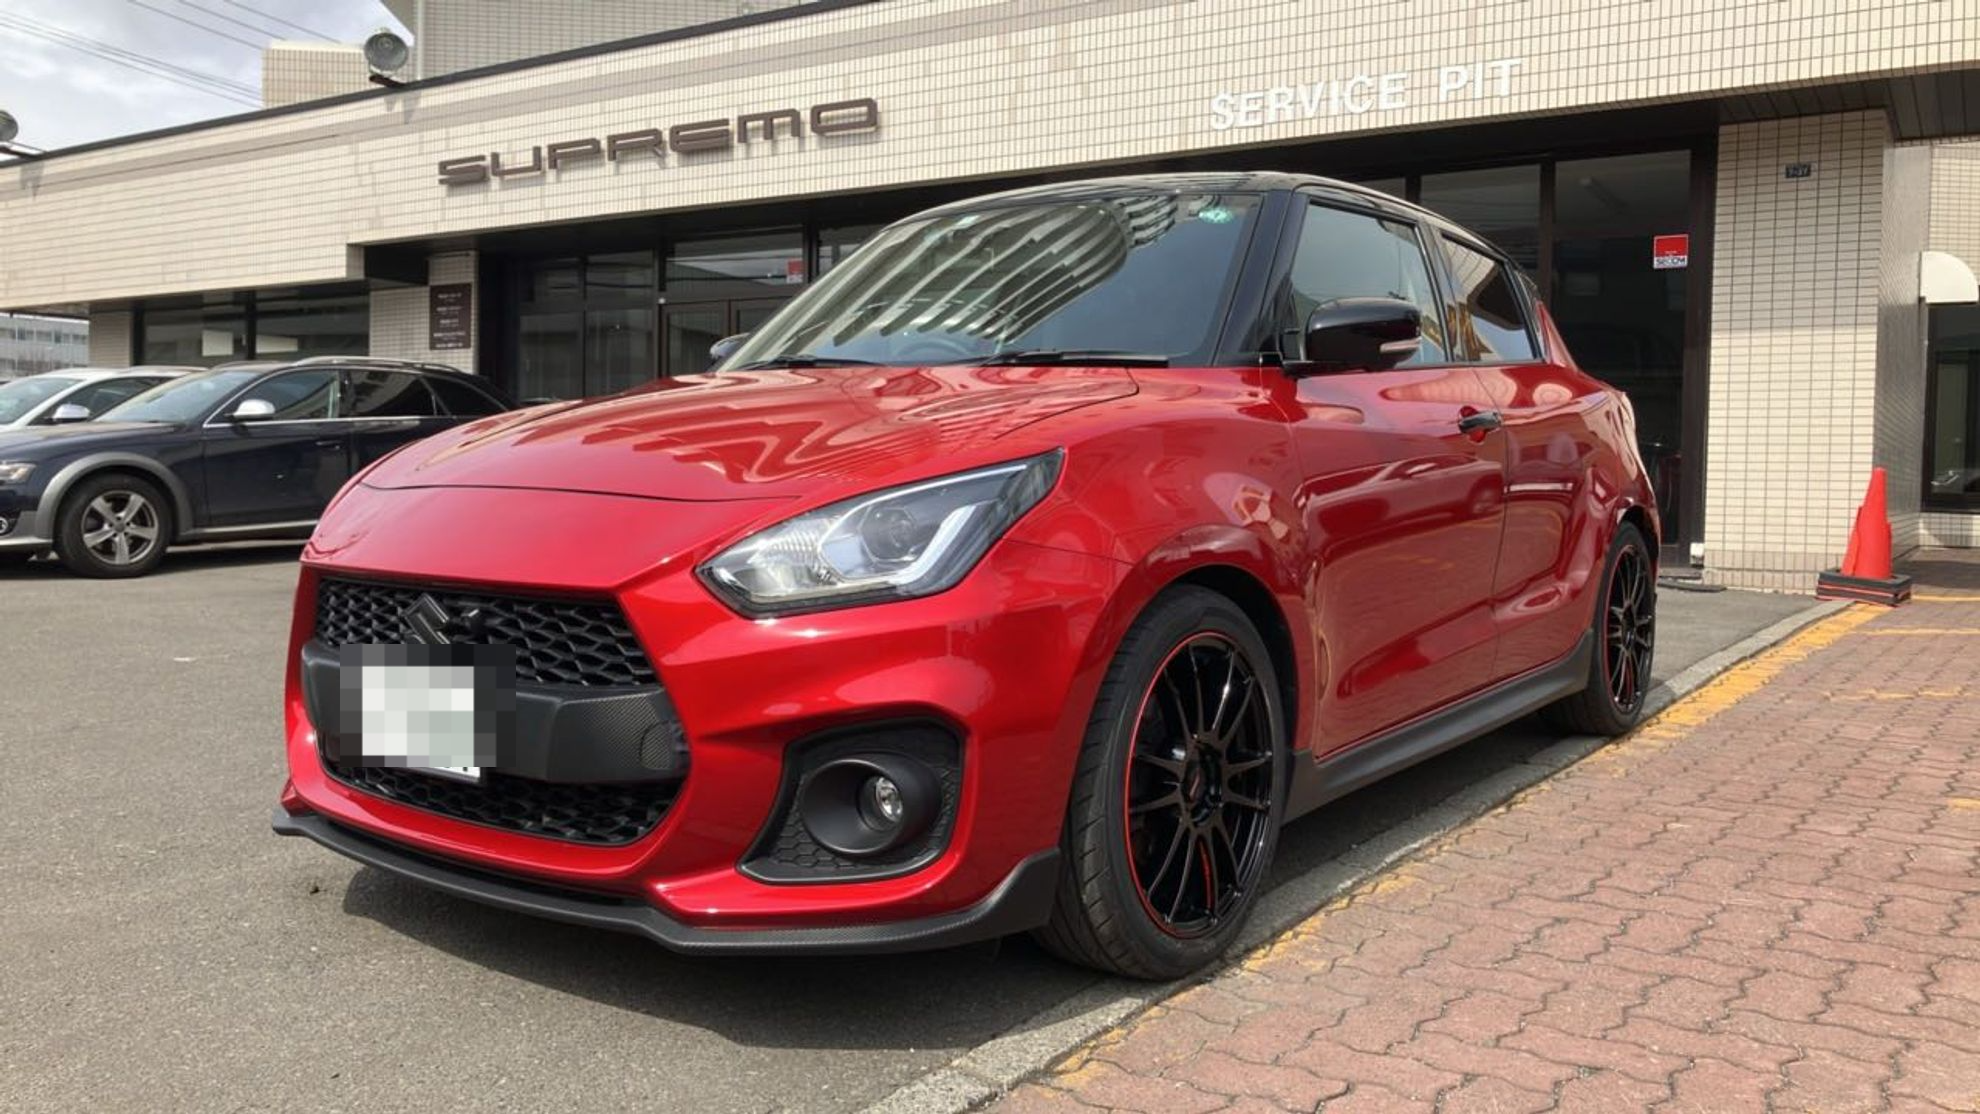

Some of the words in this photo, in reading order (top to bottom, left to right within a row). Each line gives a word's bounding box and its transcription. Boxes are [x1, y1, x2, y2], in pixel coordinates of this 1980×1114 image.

[1210, 72, 1410, 131] SERVICE
[1438, 58, 1522, 103] PIT
[438, 97, 878, 187] SUPREMO
